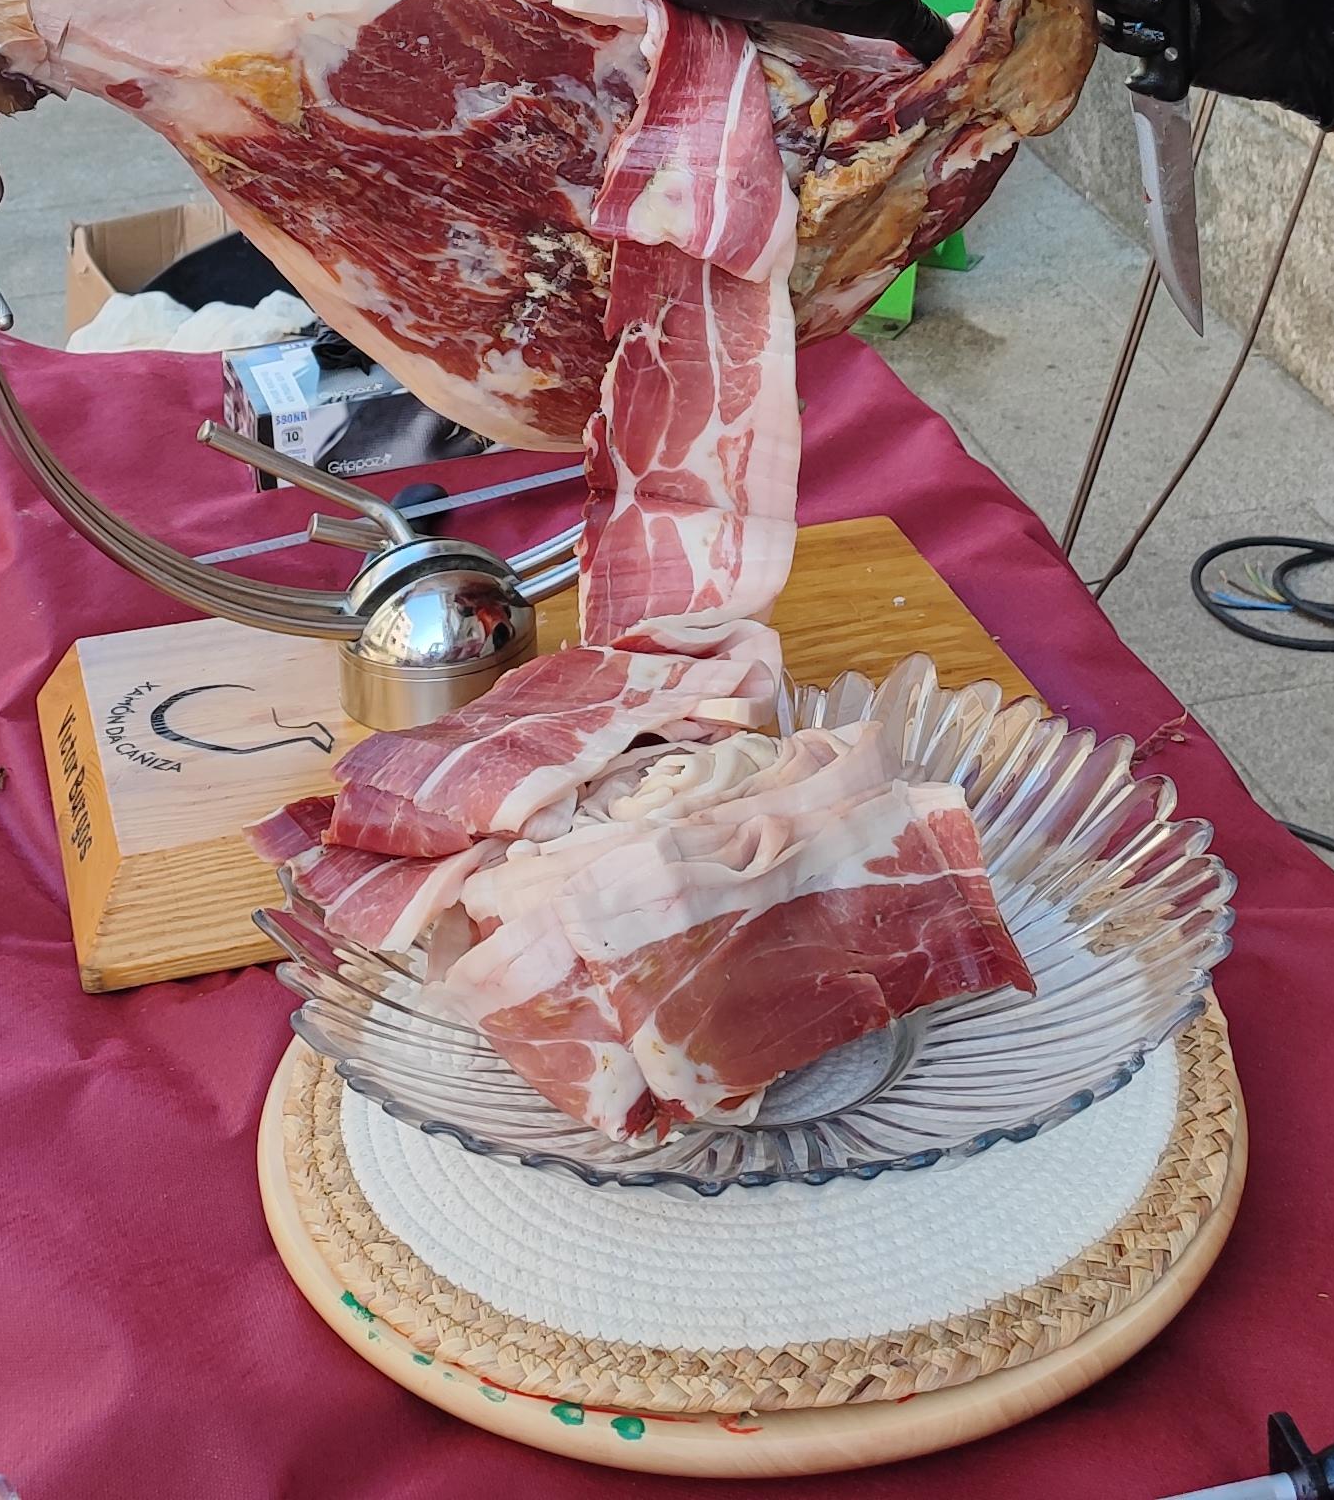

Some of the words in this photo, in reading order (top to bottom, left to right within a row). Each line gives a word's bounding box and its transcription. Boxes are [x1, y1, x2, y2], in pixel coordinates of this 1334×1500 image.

[285, 431, 299, 443] 10
[105, 681, 163, 725] XAMÓN
[105, 726, 128, 745] DA
[115, 742, 182, 773] CAÑIZA
[68, 763, 93, 863] Burgos
